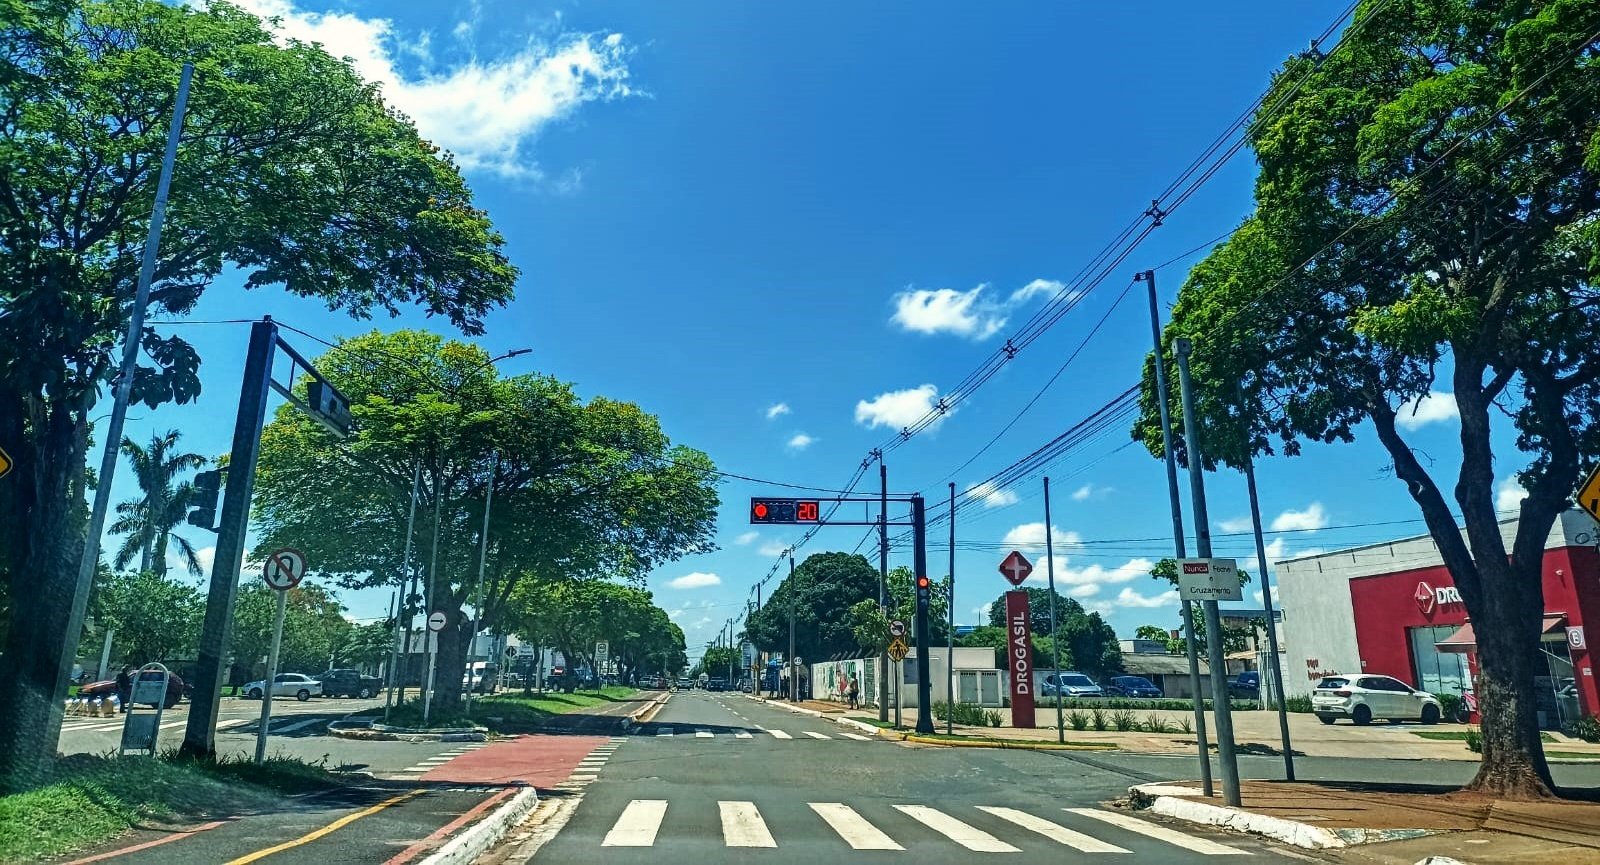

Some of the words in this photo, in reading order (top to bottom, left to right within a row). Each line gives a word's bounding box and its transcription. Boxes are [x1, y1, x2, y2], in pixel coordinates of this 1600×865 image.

[798, 503, 817, 520] 20
[1184, 564, 1208, 573] Nunca
[1190, 586, 1231, 595] Cruzamento
[1013, 611, 1029, 695] DROGASIL
